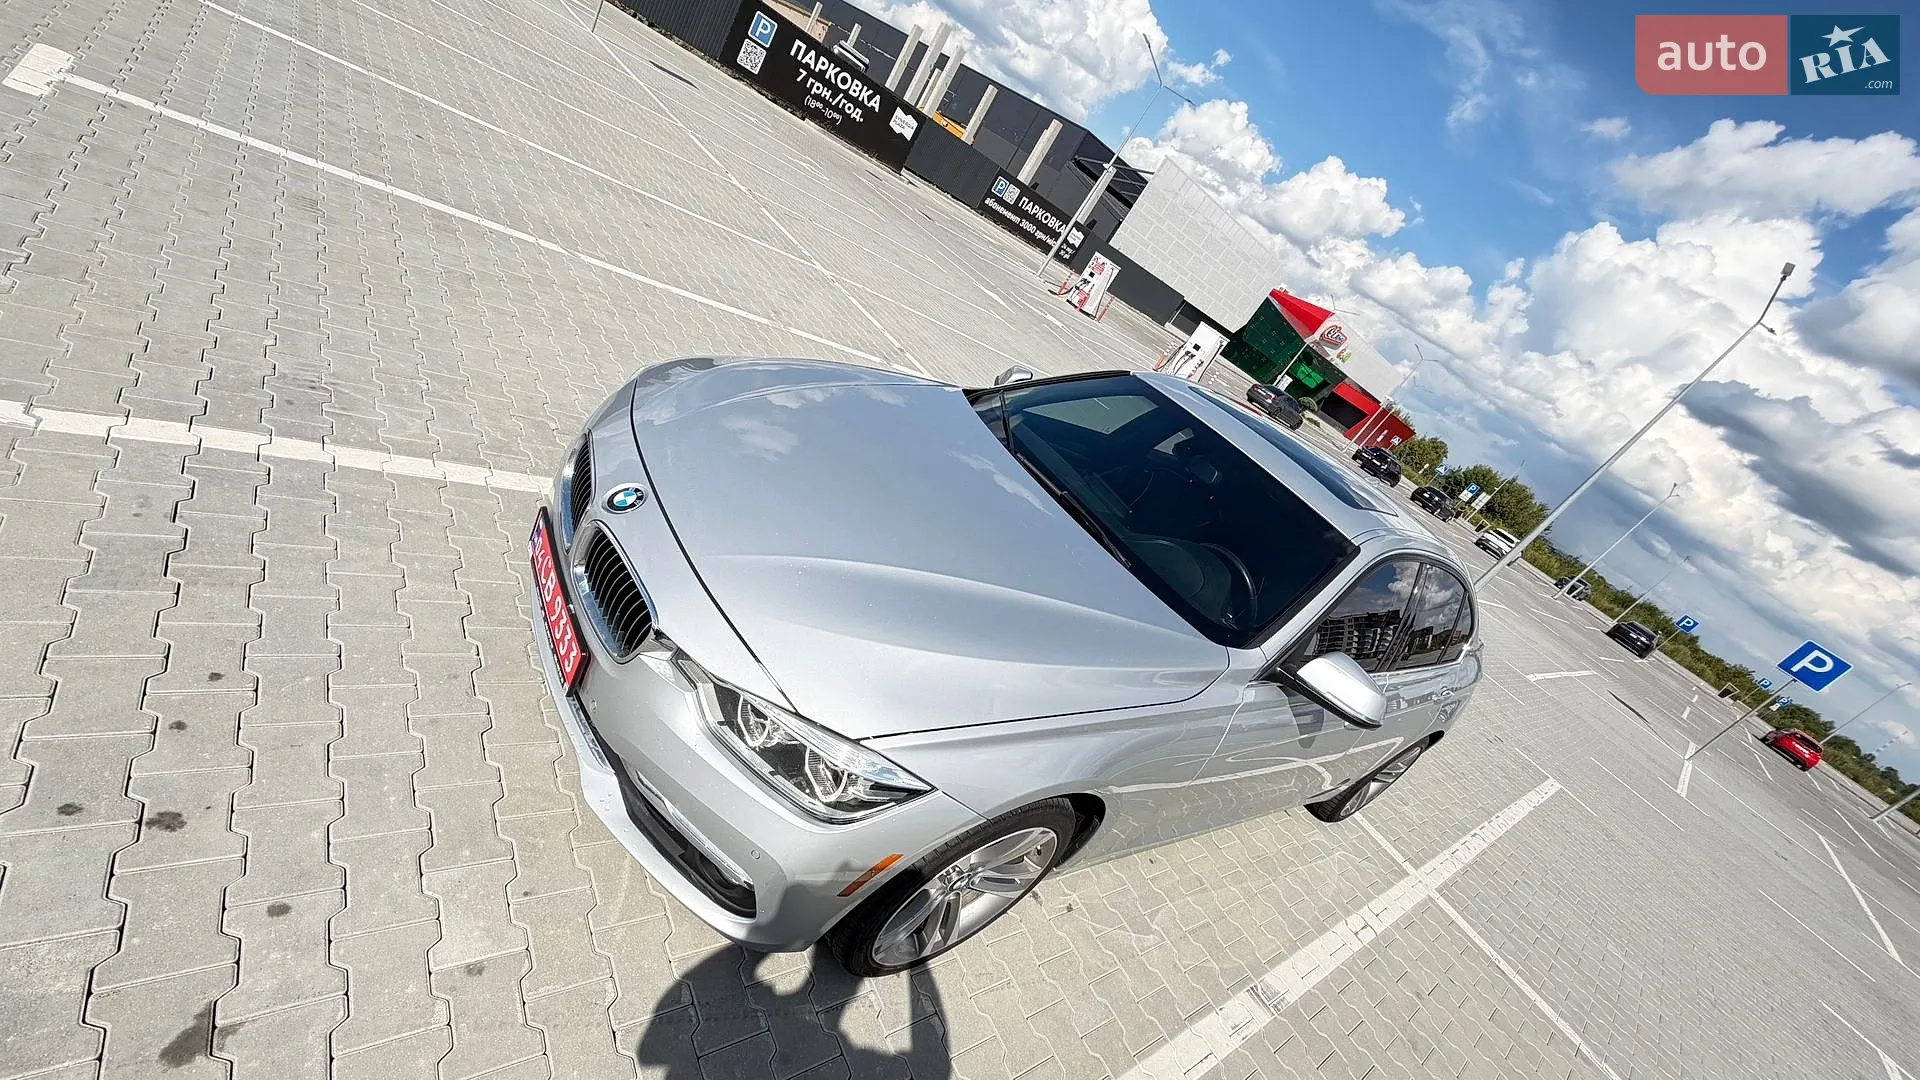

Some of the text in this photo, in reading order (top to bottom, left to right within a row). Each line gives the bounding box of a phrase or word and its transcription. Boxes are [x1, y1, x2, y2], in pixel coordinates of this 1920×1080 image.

[755, 19, 771, 37] P
[789, 38, 881, 112] ПАРКОВКА
[796, 68, 807, 82] 7
[985, 197, 1021, 224] абонемент
[1020, 219, 1037, 234] 3000
[1018, 196, 1067, 235] ПАРКОВКА
[1790, 650, 1835, 673] P
